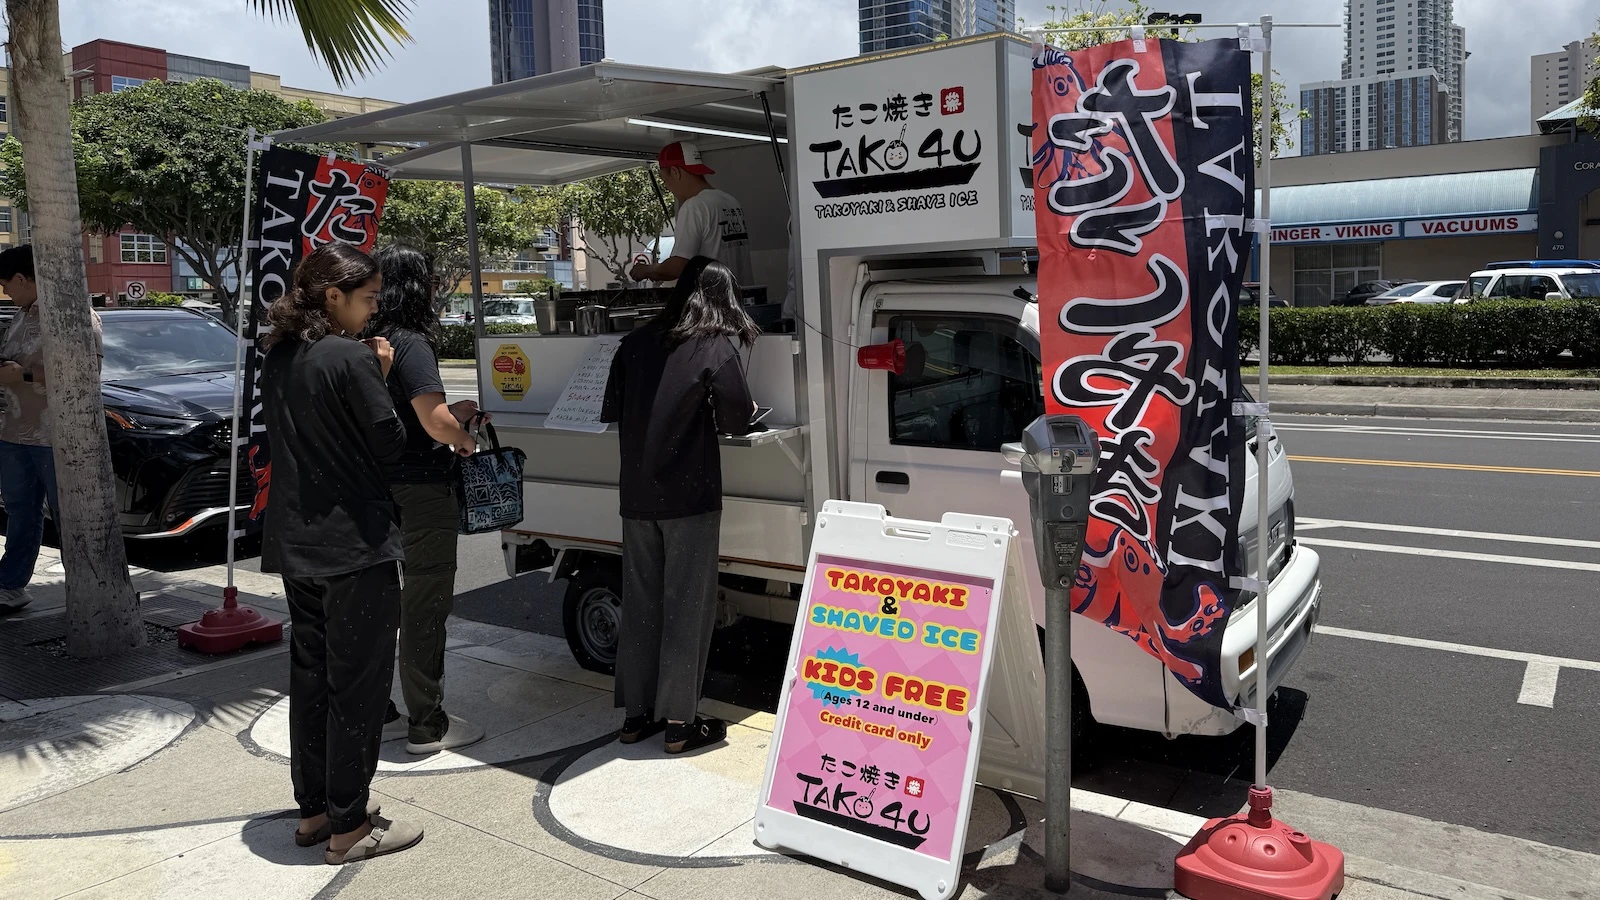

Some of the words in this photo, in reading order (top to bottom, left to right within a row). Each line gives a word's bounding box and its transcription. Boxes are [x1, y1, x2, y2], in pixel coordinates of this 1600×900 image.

[832, 92, 933, 129] たこ焼き
[809, 131, 909, 179] TAKO
[917, 128, 982, 167] 4U
[815, 199, 884, 219] TAKOYAKI
[885, 198, 896, 213] &
[897, 193, 945, 212] SHAVE
[950, 190, 979, 208] ICE
[1336, 223, 1394, 238] VIKING
[1421, 216, 1519, 235] VACUUMS
[826, 569, 968, 608] TAKOYAKI
[881, 595, 898, 615] &
[811, 605, 915, 640] SHAVED
[923, 624, 979, 652] ICE
[804, 659, 875, 692] KIDS
[885, 675, 968, 712] FREE
[855, 698, 870, 710] 12
[872, 703, 895, 716] and
[819, 710, 862, 731] Credit
[863, 722, 896, 740] card
[897, 729, 932, 750] only
[820, 753, 901, 791] たこ焼き
[796, 772, 874, 819] TAKO
[879, 800, 931, 835] 4U
